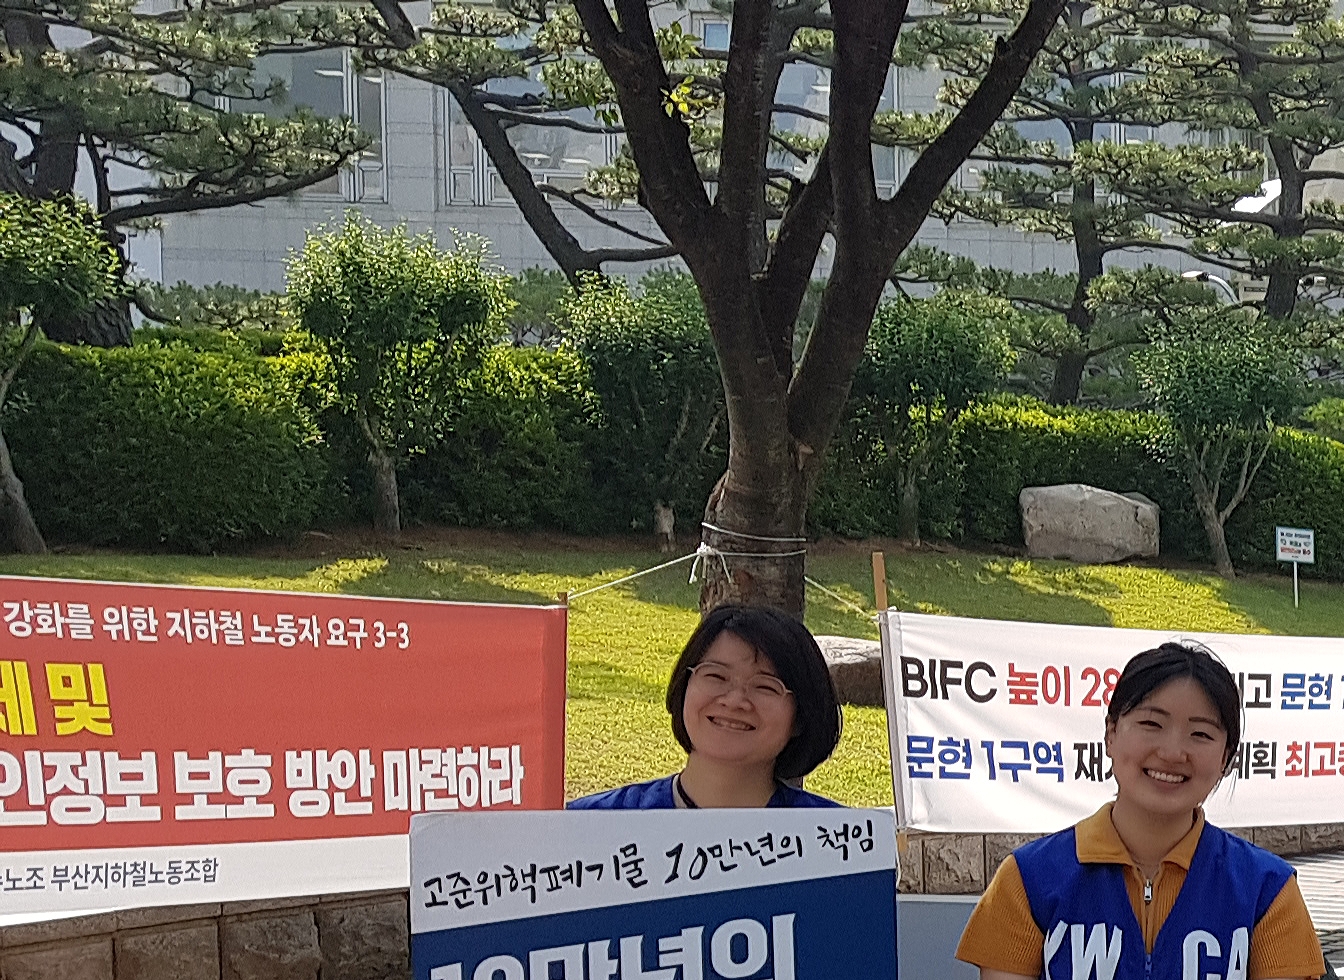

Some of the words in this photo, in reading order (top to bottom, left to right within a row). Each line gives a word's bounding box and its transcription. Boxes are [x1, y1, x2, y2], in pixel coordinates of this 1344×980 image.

[3, 600, 95, 640] 강화를
[103, 605, 159, 642] 위한
[165, 608, 245, 646] 지하철
[250, 614, 321, 648] 노동자
[326, 617, 369, 649] 요구
[372, 621, 410, 649] 3-3
[45, 662, 114, 736] 및
[900, 656, 998, 704] BIFC
[1006, 662, 1071, 707] 높이
[1281, 672, 1334, 711] 문현
[173, 748, 275, 820] 보호
[285, 749, 376, 818] 방안
[382, 744, 524, 812] 마련하라
[906, 735, 973, 780] 문현
[980, 740, 1065, 783] 1구역
[0, 866, 46, 892] 노조
[50, 857, 220, 892] 부산지하철노동조합
[423, 843, 648, 909] 고준위핵폐기물
[665, 832, 803, 885] 10만년의
[817, 819, 876, 860] 책임
